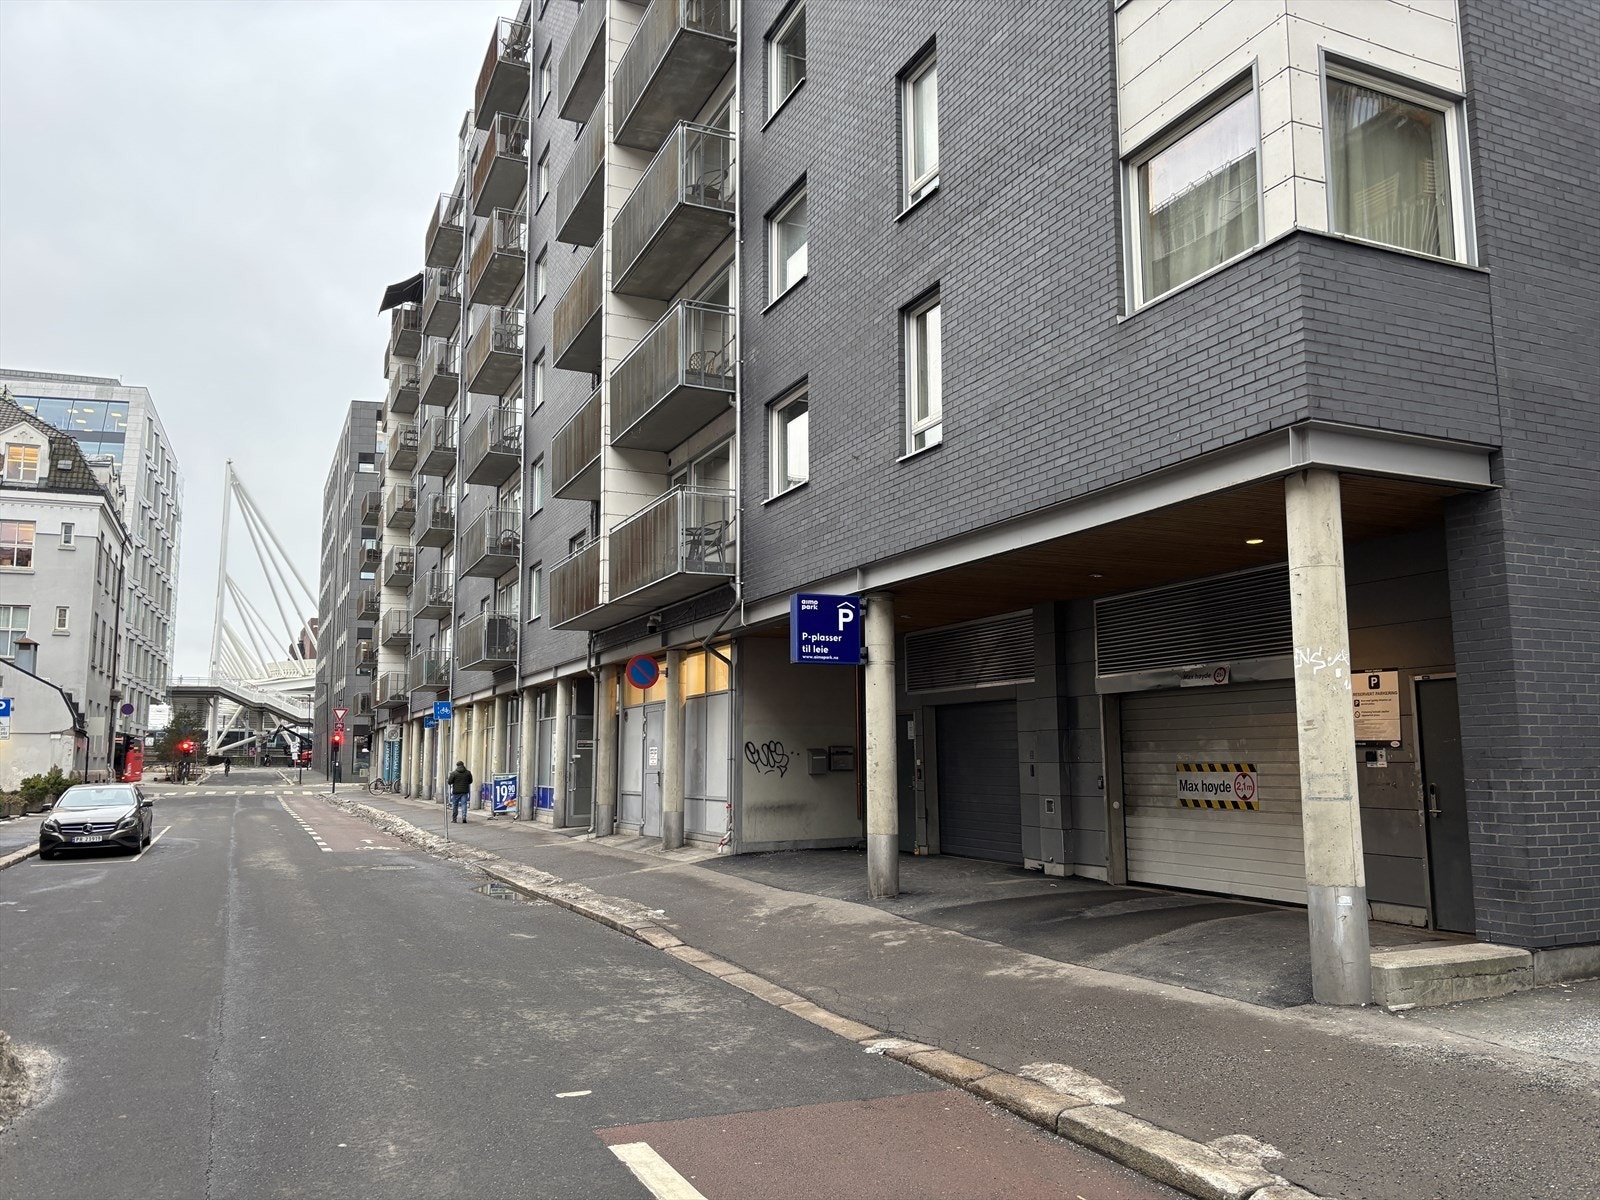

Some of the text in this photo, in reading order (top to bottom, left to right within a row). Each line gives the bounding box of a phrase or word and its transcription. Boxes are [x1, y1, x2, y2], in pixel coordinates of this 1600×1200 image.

[838, 608, 854, 631] P
[802, 632, 842, 643] P-plasser
[802, 645, 829, 654] til leie
[1370, 676, 1378, 687] P
[1179, 779, 1199, 793] Max
[1201, 779, 1231, 796] høyde
